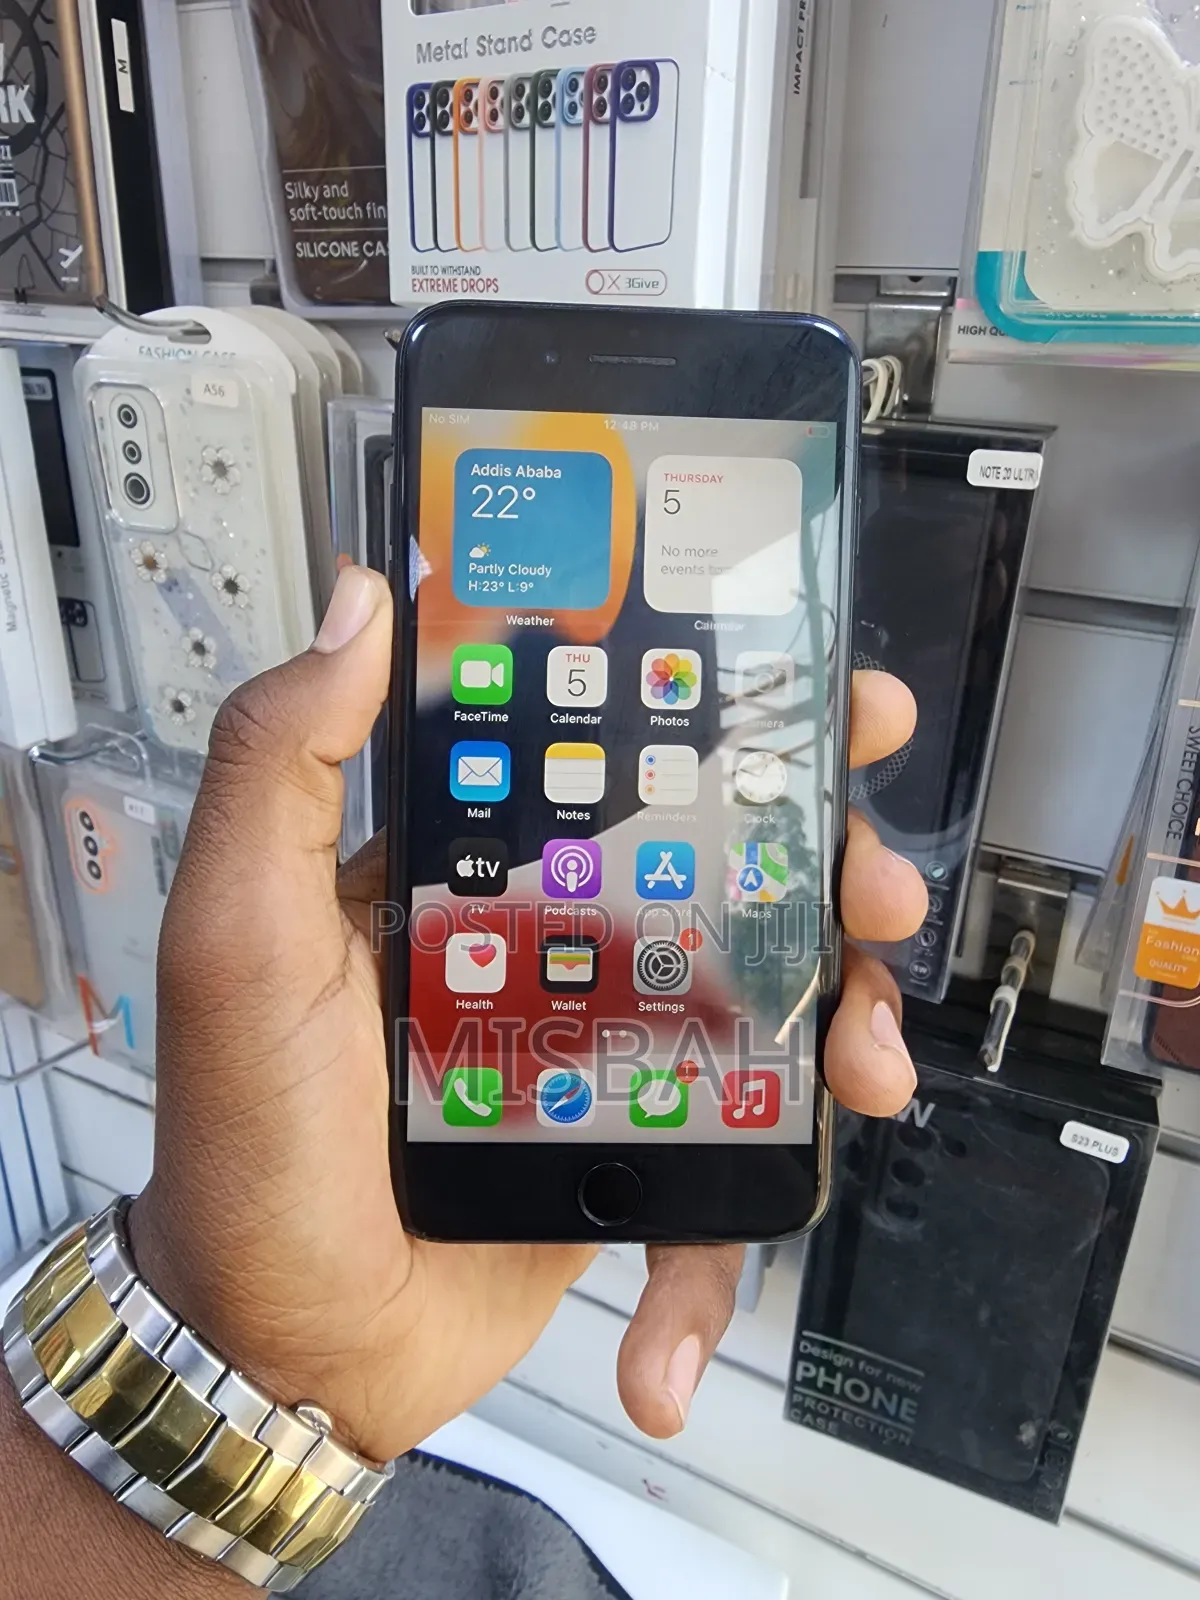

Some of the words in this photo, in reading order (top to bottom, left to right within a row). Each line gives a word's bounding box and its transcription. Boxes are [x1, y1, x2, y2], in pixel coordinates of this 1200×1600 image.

[416, 37, 468, 64] Metal
[476, 29, 532, 57] Stand
[541, 26, 597, 49] Case
[793, 25, 804, 95] IMPACT
[285, 181, 319, 202] Silky
[323, 180, 349, 198] and
[289, 202, 363, 221] soft-touch
[295, 241, 361, 258] SILICONE
[362, 241, 389, 257] CA
[411, 265, 429, 275] BUILT
[430, 265, 440, 275] TO
[441, 265, 481, 276] WITHSTAND
[411, 278, 459, 293] EXTREME
[461, 278, 500, 294] DROPS
[957, 325, 987, 336] HIGH
[429, 413, 445, 424] No
[449, 414, 470, 425] SIM
[603, 419, 637, 431] 12:48
[641, 421, 659, 432] PM
[470, 463, 512, 477] Addis
[515, 465, 562, 479] Ababa
[663, 473, 725, 483] THURSDAY
[979, 465, 1002, 480] NOTE
[471, 484, 537, 519] 22°
[663, 489, 681, 515] 5
[661, 544, 680, 557] No
[684, 547, 719, 558] more
[468, 562, 505, 577] Partly
[508, 563, 552, 578] Cloudy
[660, 564, 705, 575] events
[0, 574, 18, 632] Magnetic
[506, 615, 555, 626] Weather
[565, 653, 591, 663] THU
[567, 669, 587, 697] 5
[454, 710, 509, 722] FaceTime
[550, 712, 602, 724] Calendar
[650, 715, 690, 727] Photos
[467, 807, 491, 819] Mail
[556, 809, 591, 821] Notes
[1166, 778, 1193, 840] CHOICE
[637, 811, 698, 822] Reminders
[744, 812, 776, 824] Clock
[469, 904, 486, 915] TV
[544, 904, 597, 916] Podcasts
[741, 908, 772, 920] Maps
[1145, 935, 1200, 957] Fashion
[1149, 958, 1189, 974] QUALITY
[455, 999, 494, 1011] Health
[551, 1000, 587, 1012] Wallet
[638, 1001, 685, 1014] Settings
[1091, 1140, 1119, 1157] PLUS
[799, 1340, 855, 1368] Design
[858, 1360, 882, 1378] for
[886, 1373, 922, 1393] new
[796, 1360, 918, 1424] PHONE
[790, 1408, 840, 1435] CASE
[793, 1393, 912, 1446] PROTECTION
